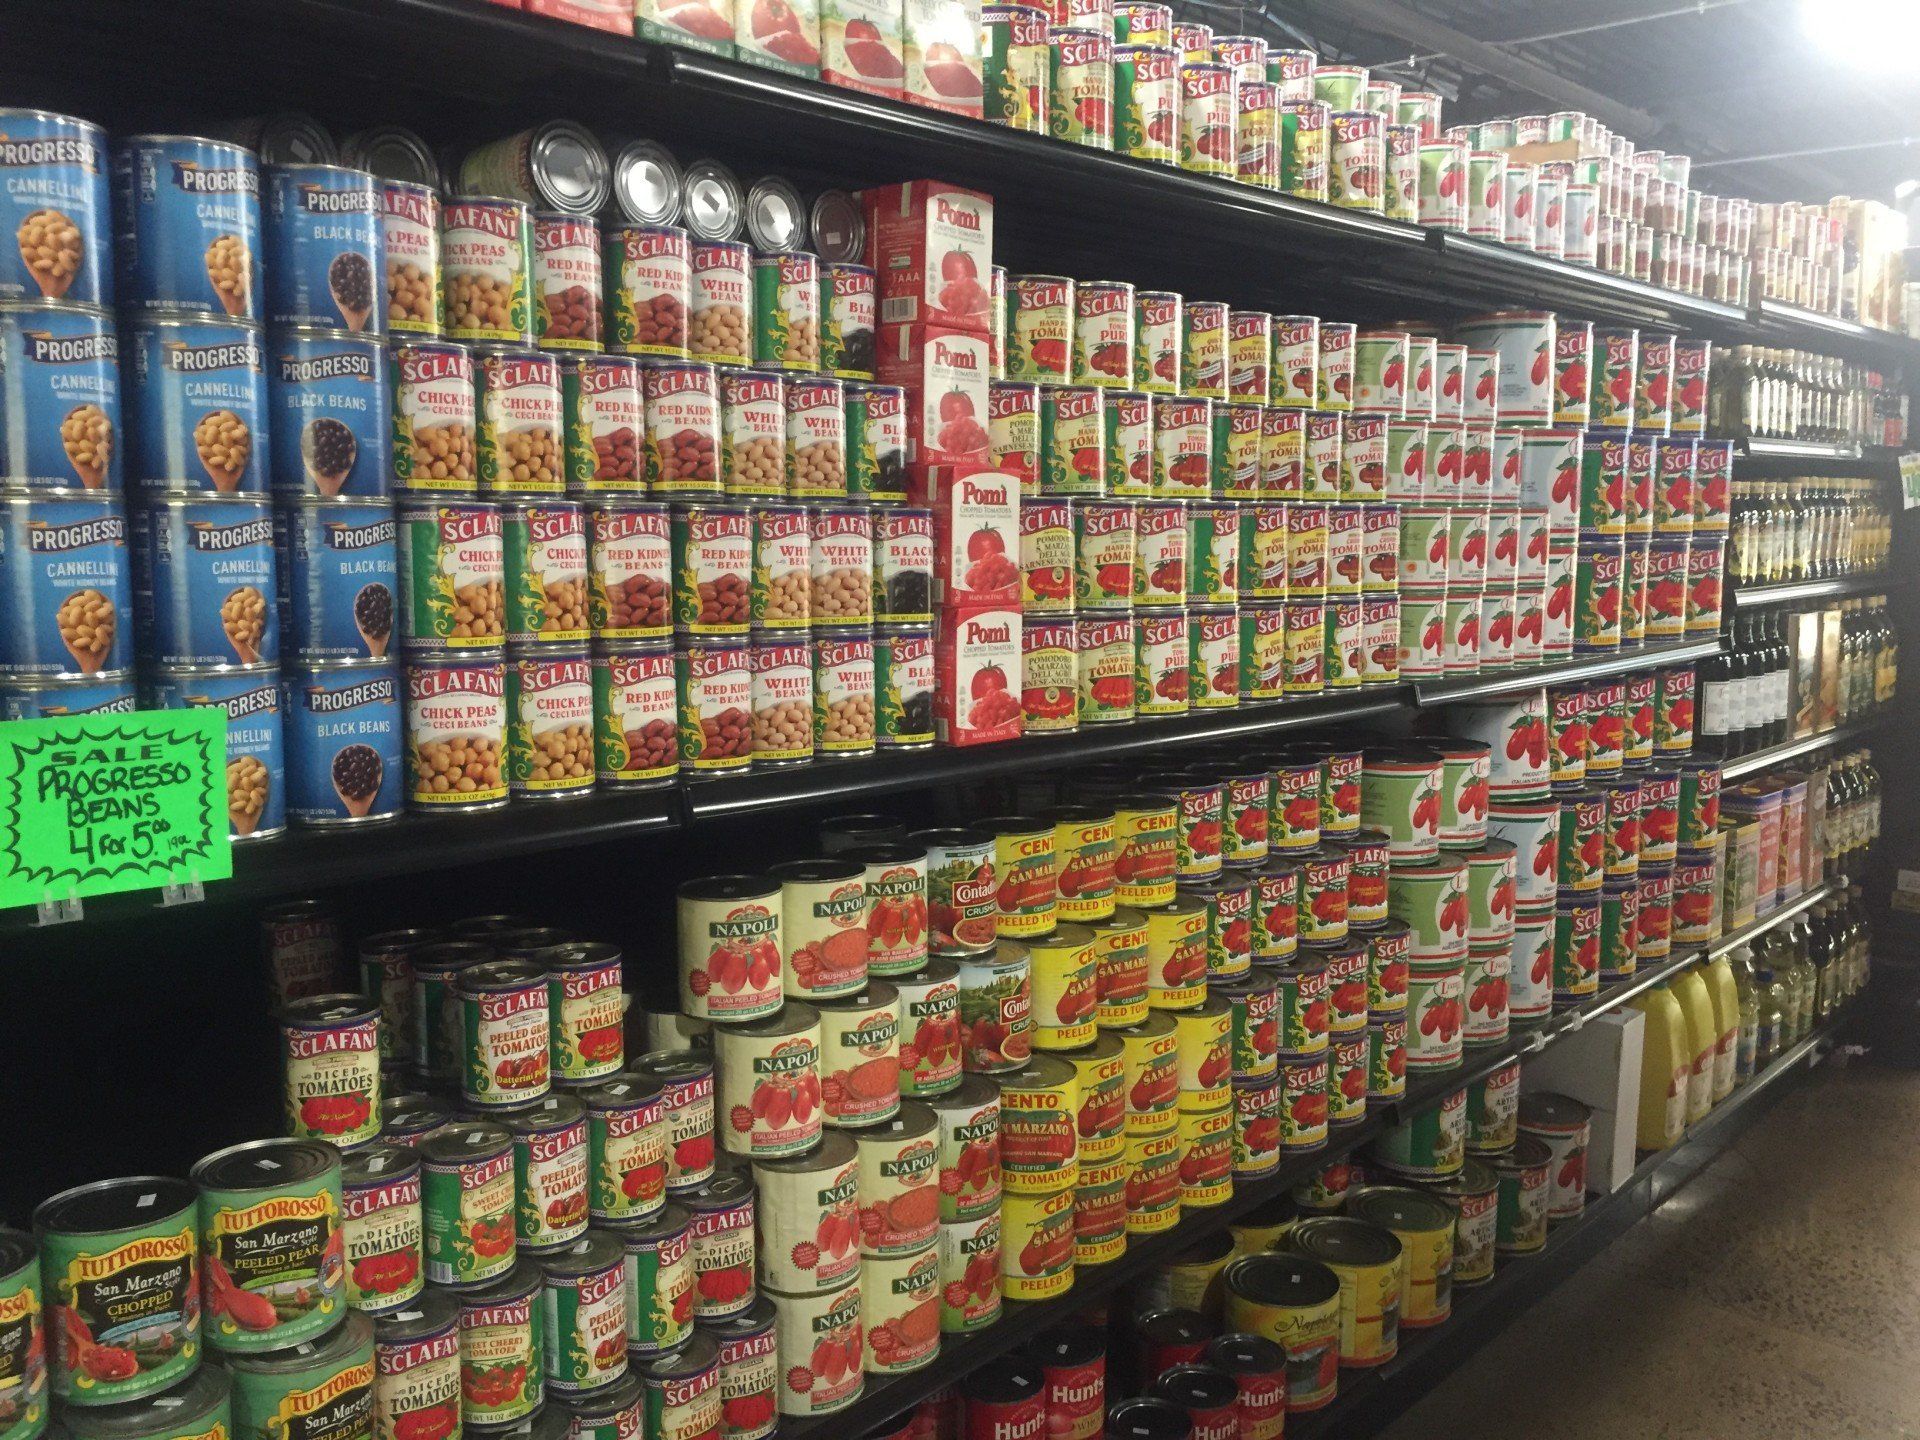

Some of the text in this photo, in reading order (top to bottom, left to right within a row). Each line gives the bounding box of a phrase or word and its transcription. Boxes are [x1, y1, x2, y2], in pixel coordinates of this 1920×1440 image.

[472, 243, 506, 257] PEAS
[546, 258, 573, 270] RED
[637, 268, 660, 280] RED
[172, 347, 260, 371] PROGRESSO
[282, 354, 369, 380] PROGRESSO
[287, 394, 367, 412] BLACK BEANS
[418, 391, 459, 406] CHICK
[501, 397, 541, 412] CHICK
[594, 401, 621, 413] RED
[658, 404, 683, 416] RED
[674, 415, 712, 426] BEANS
[962, 480, 1009, 506] Pomì
[32, 519, 123, 550] PROGRESSO
[459, 549, 495, 563] CHICK
[546, 547, 580, 561] CHICK
[608, 548, 634, 561] RED
[701, 549, 726, 560] RED
[819, 544, 869, 558] WHITE
[340, 562, 375, 576] BLACK
[625, 560, 664, 571] BEANS
[830, 557, 865, 567] BEANS
[899, 556, 931, 567] BEANS
[966, 621, 1011, 646] Pomì
[409, 669, 504, 698] SCLAFANI
[703, 684, 728, 696] RED
[765, 676, 811, 690] WHITE
[311, 679, 393, 712] PROGRESSO
[626, 693, 651, 705] RED
[774, 687, 807, 699] BEANS
[536, 698, 576, 711] CHICK
[420, 704, 498, 721] CHICK PEAS
[550, 708, 570, 719] CECI
[317, 720, 392, 738] BLACK BEANS
[433, 718, 489, 730] CECI BEANS
[51, 744, 164, 768] SALE
[37, 761, 192, 803] PROGRESSO
[67, 792, 161, 829] BEANS
[69, 827, 95, 865] 4
[1126, 843, 1148, 858] SAN
[1070, 856, 1095, 873] SAN
[1009, 871, 1033, 886] SAN
[870, 880, 925, 897] NAPOLI
[1115, 885, 1154, 898] PEELED
[1058, 899, 1099, 912] PEELED
[716, 919, 777, 937] NAPOLI
[998, 914, 1039, 927] PEELED
[1163, 985, 1200, 1000] PEELED
[490, 1025, 530, 1045] PEELED
[846, 1023, 898, 1046] NAPOLI
[1057, 1025, 1093, 1039] PEELED
[289, 1029, 378, 1058] SCLAFANI
[760, 1049, 816, 1072] NAPOLI
[313, 1066, 361, 1081] DICED
[496, 1073, 535, 1086] Datterini
[297, 1073, 374, 1096] TOMATOES
[1012, 1123, 1069, 1136] MARZANO
[1010, 1163, 1046, 1172] CERTIFIED
[541, 1168, 572, 1184] PEELED
[1021, 1166, 1076, 1185] TOMATOES
[222, 1195, 328, 1231] TUTTOROSSO
[234, 1225, 320, 1250] San Marzano
[367, 1223, 411, 1241] DICED
[348, 1230, 421, 1259] TOMATOES
[709, 1241, 745, 1256] DICED
[79, 1233, 191, 1278] TUTTOROSSO
[234, 1243, 321, 1270] PEELED PEAR
[695, 1248, 753, 1270] TOMATOES
[94, 1264, 183, 1297] San Marzano
[106, 1289, 174, 1317] CHOPPED
